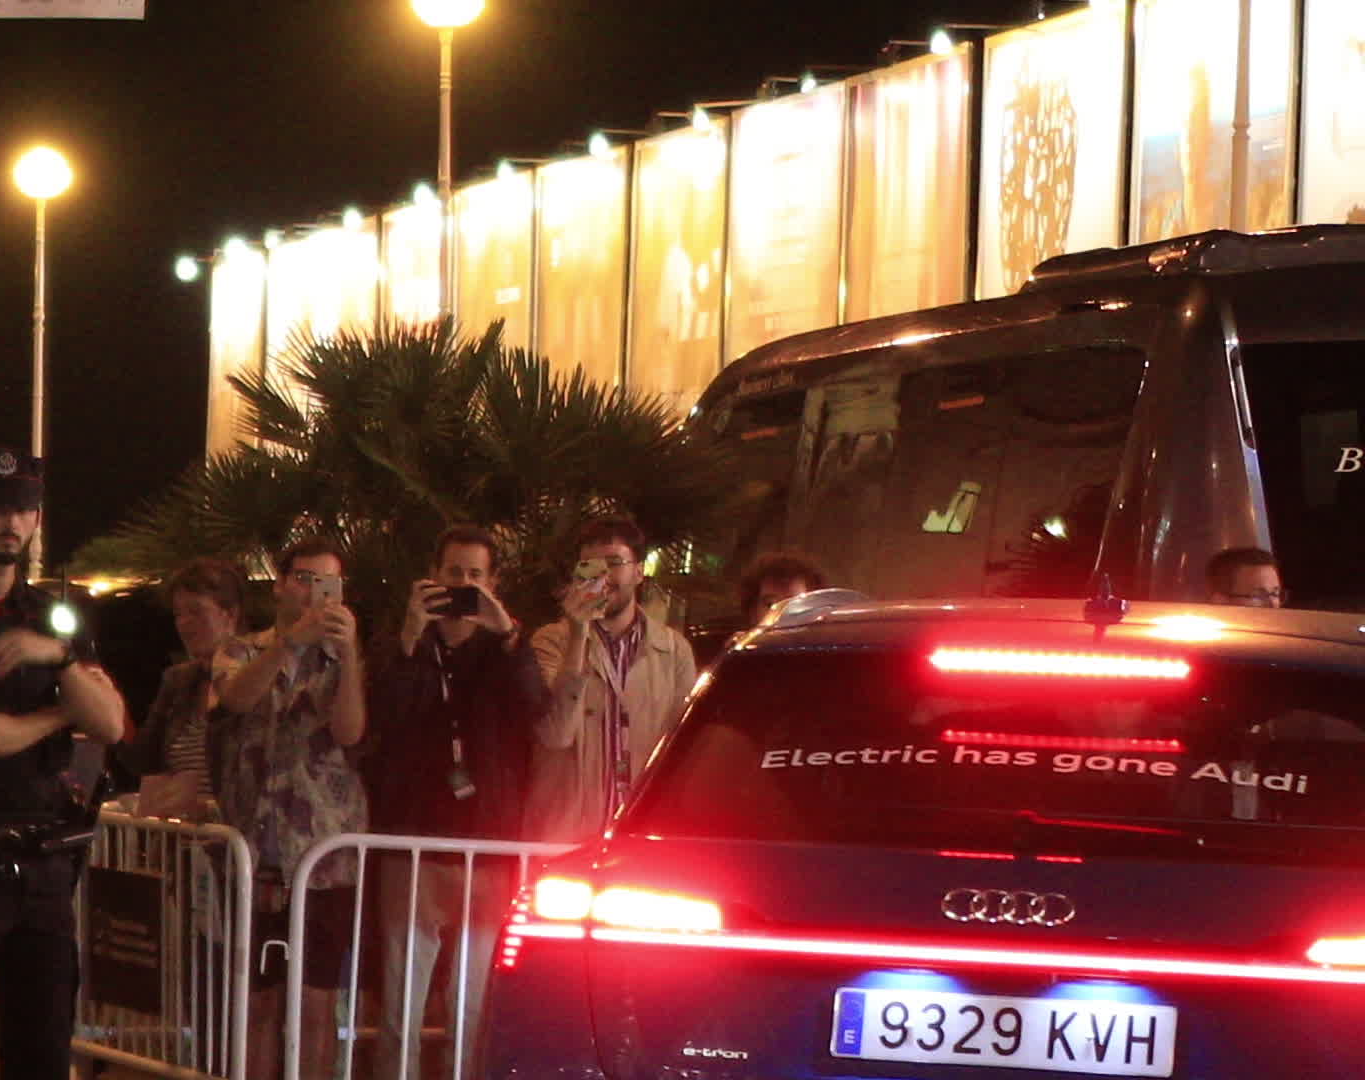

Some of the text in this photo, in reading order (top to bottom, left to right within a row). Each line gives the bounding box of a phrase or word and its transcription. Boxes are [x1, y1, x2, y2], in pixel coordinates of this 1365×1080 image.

[760, 745, 1308, 794] Electric has gone Audi
[878, 1001, 1157, 1066] 9329 KVH
